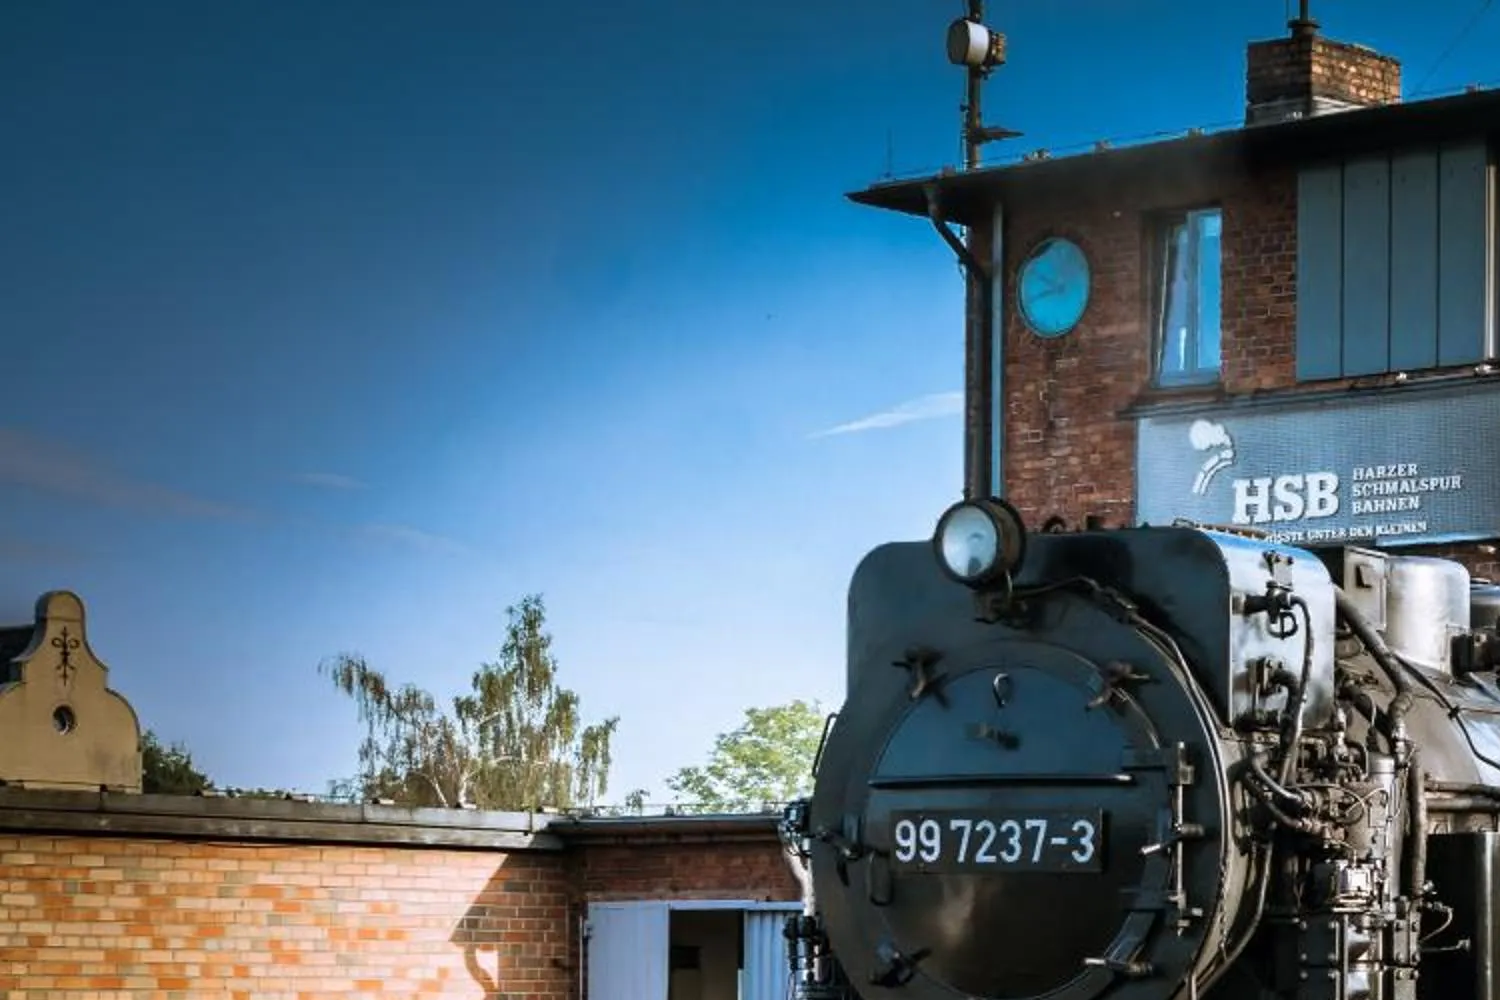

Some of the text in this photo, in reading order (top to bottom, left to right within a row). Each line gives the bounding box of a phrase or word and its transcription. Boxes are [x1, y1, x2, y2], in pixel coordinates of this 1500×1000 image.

[1352, 463, 1419, 481] HARZER
[1231, 470, 1340, 525] HSB
[1351, 475, 1463, 498] SCHMALSPUR
[1351, 495, 1421, 516] BAHNEN
[1349, 525, 1374, 538] DEN
[894, 818, 1096, 864] 99 7237-3
